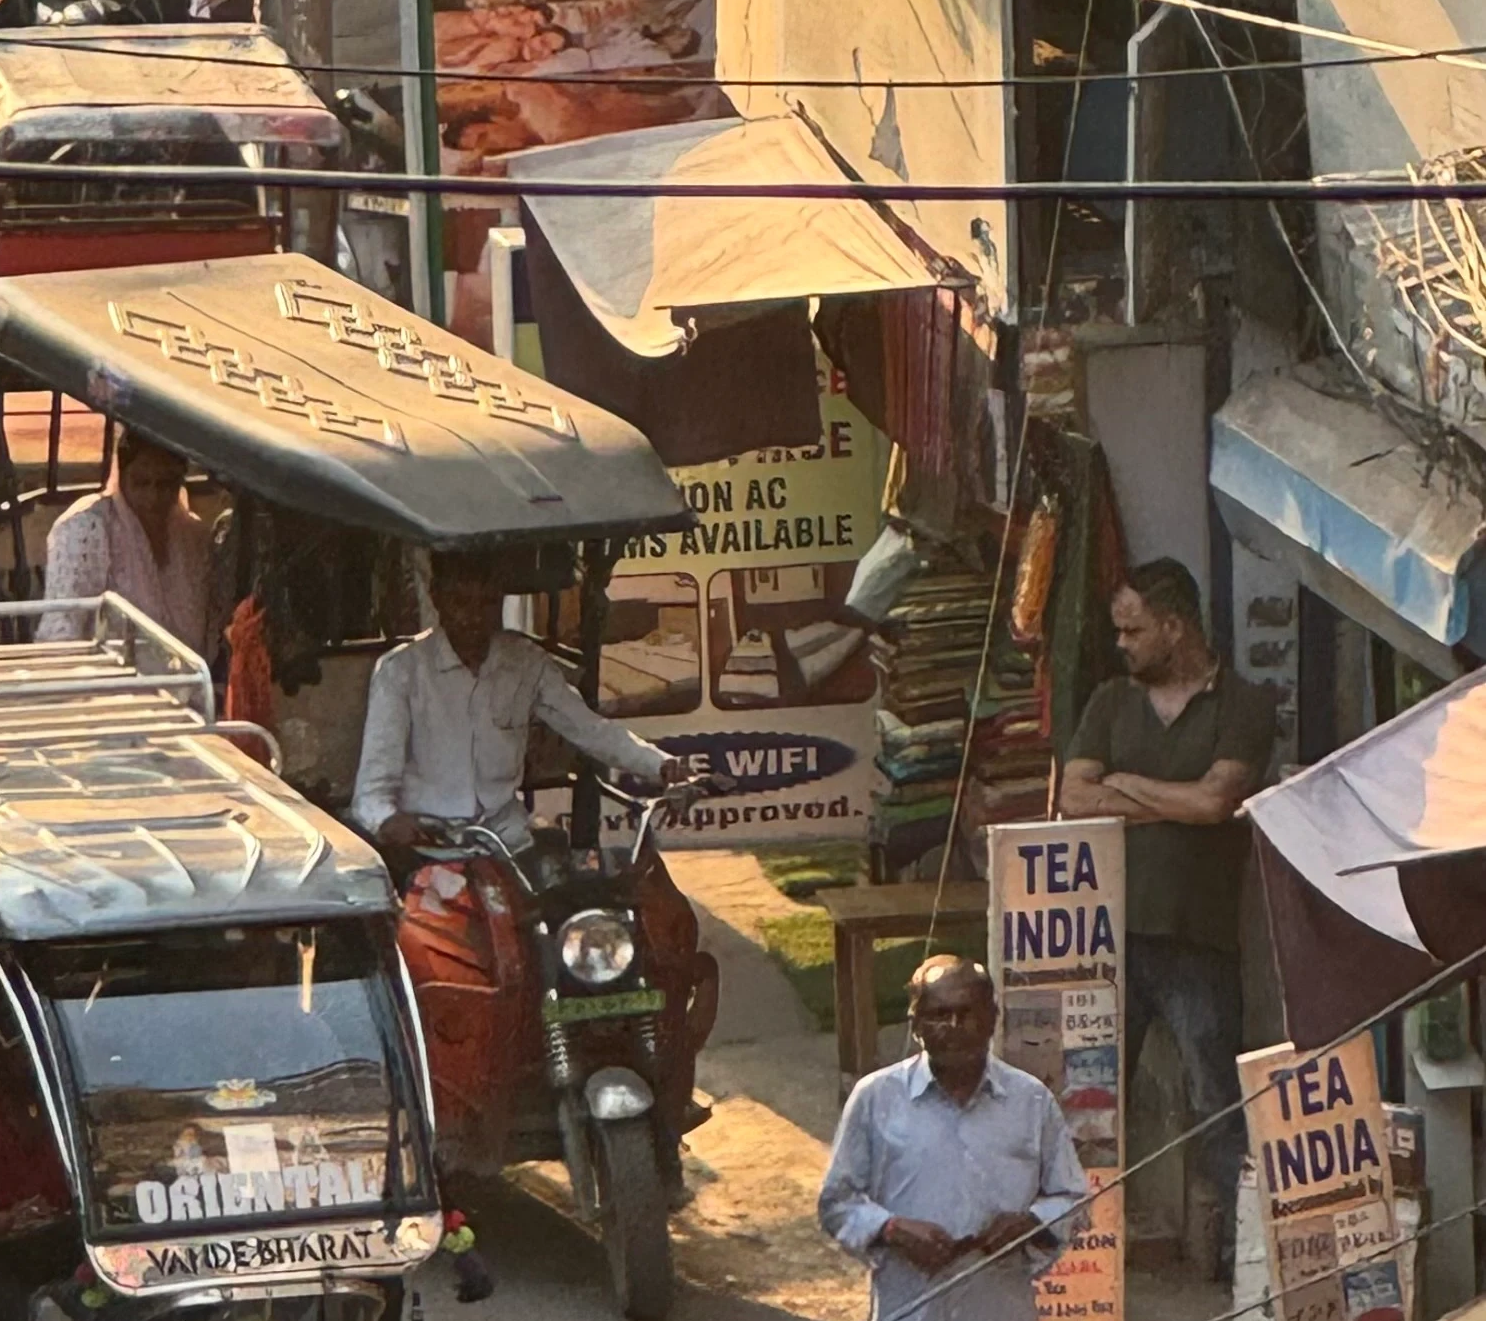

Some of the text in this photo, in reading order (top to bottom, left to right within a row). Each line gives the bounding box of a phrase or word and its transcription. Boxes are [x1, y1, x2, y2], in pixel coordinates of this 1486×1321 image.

[745, 477, 787, 510] AC
[679, 514, 854, 555] AVAILABLE
[725, 746, 818, 777] WIFI
[1018, 841, 1099, 895] TEA
[1003, 904, 1117, 961] INDIA
[1269, 1057, 1354, 1121] TEA
[1263, 1118, 1381, 1194] INDIA
[135, 1160, 384, 1224] ORIENTAL
